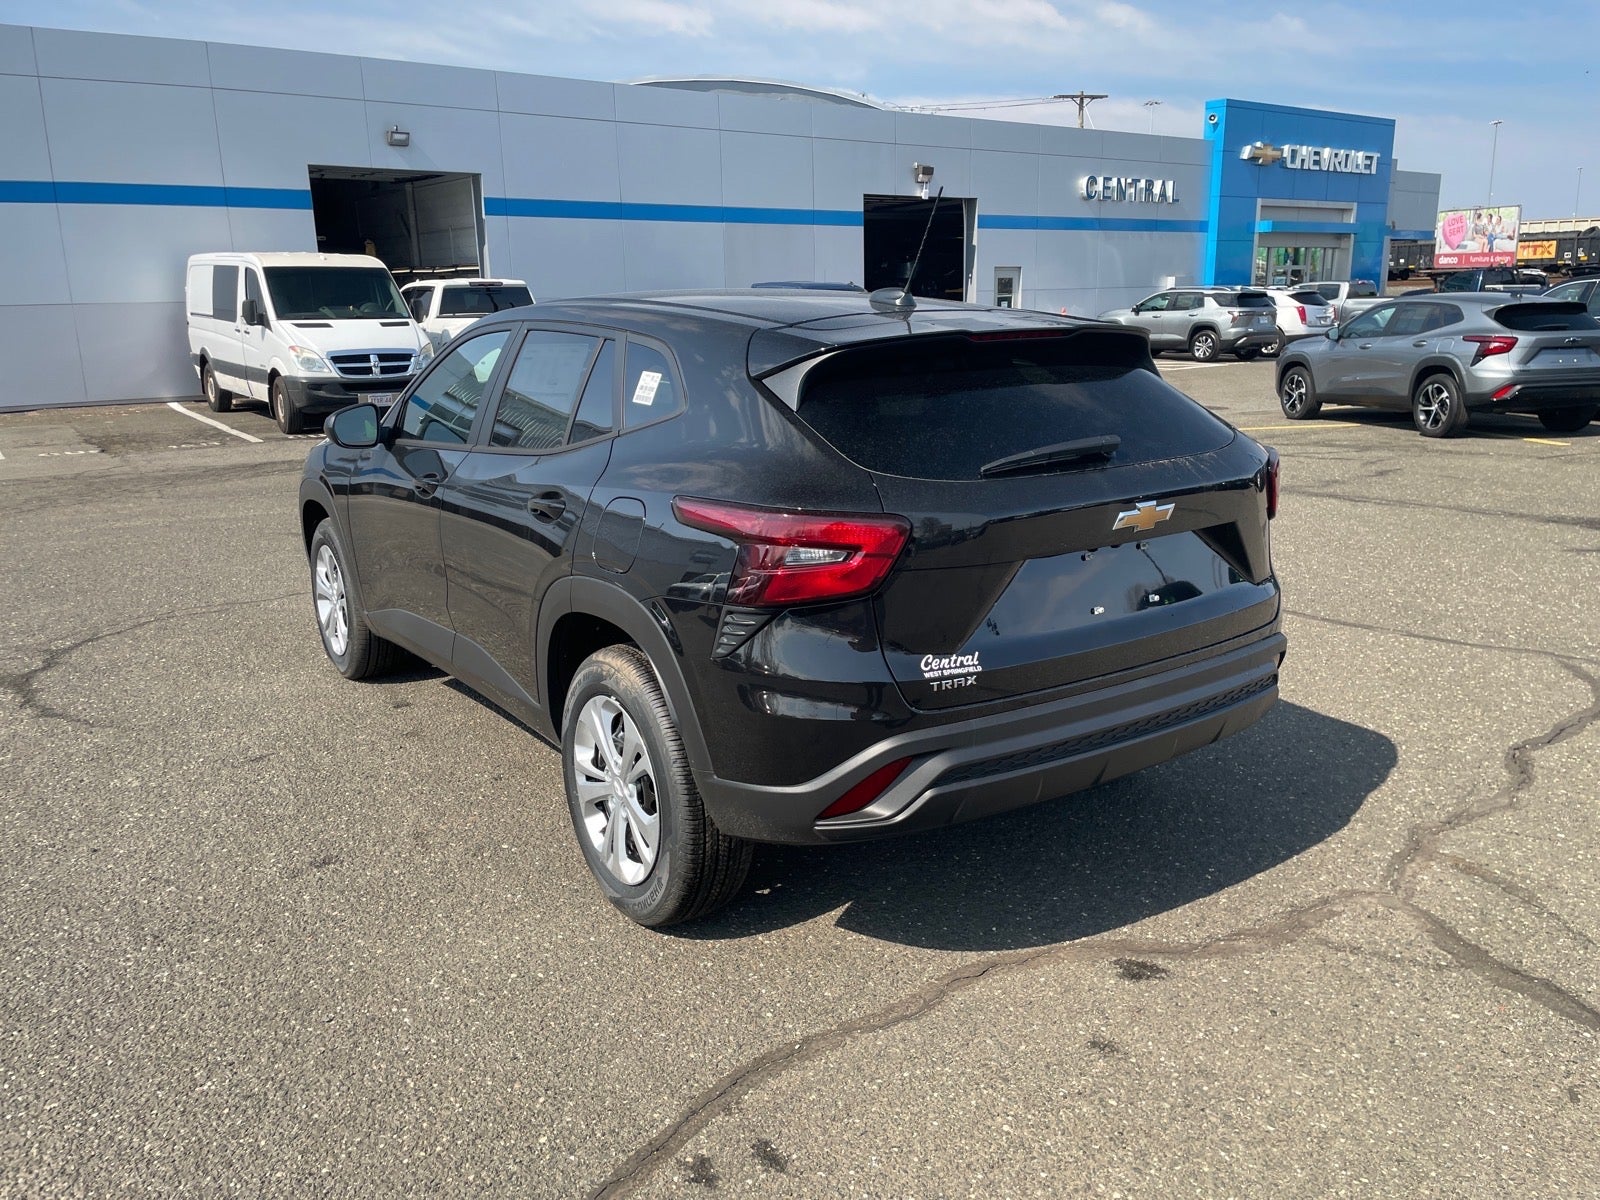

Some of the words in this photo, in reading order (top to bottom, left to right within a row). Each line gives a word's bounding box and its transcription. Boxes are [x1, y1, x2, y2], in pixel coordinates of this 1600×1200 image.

[1283, 144, 1381, 175] CHEVROLET
[1083, 174, 1180, 204] CENTRAL
[1447, 215, 1464, 227] LOVE
[1448, 226, 1464, 236] SEAT
[1519, 243, 1553, 256] TTX
[1438, 255, 1458, 265] danco
[920, 651, 979, 671] Central
[923, 670, 942, 679] WEST
[942, 665, 983, 676] SPRINGFIELD
[929, 675, 977, 692] TRAX
